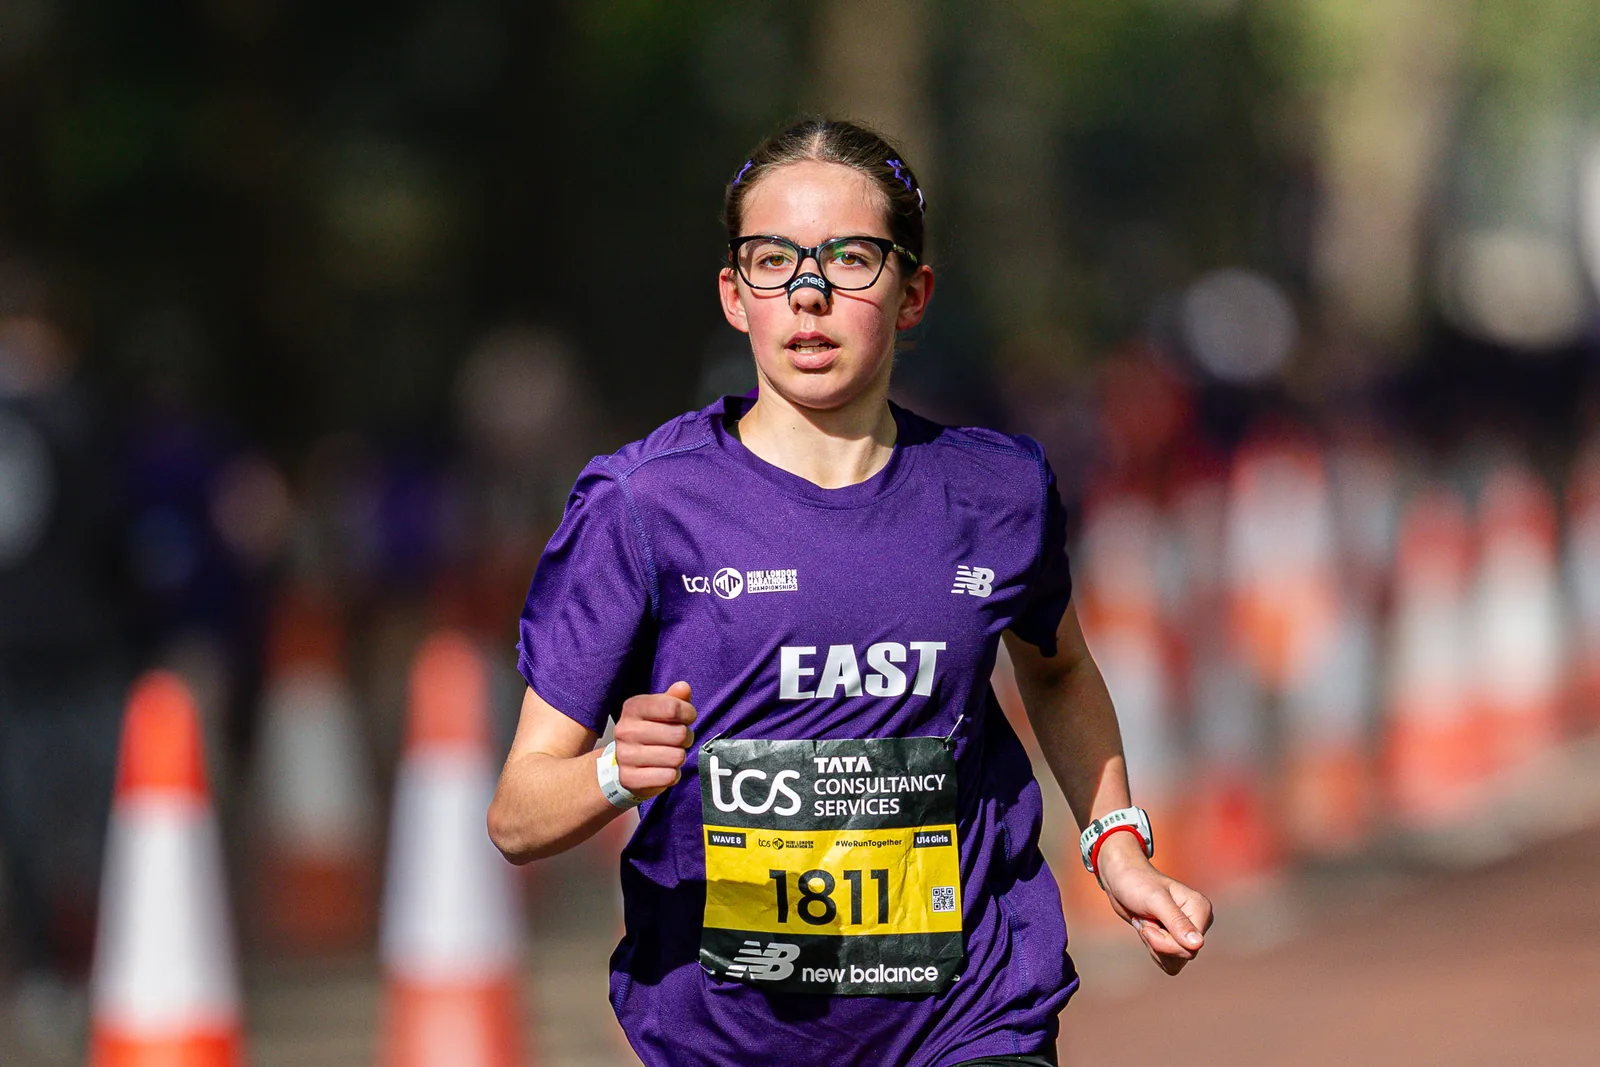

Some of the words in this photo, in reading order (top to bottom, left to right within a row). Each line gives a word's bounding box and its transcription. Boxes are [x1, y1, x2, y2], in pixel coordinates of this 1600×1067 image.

[747, 571, 764, 579] MINI
[765, 569, 797, 578] LONDON
[747, 577, 786, 586] MARATHON
[682, 574, 711, 594] tcs
[748, 584, 797, 592] CHAMPIONSHIPS
[779, 641, 947, 700] EAST
[814, 756, 872, 774] TATA
[709, 755, 802, 816] tcs
[813, 774, 946, 796] CONSULTANCY
[814, 798, 900, 817] SERVICES
[712, 835, 735, 844] WAVE
[736, 837, 742, 845] 8
[758, 838, 771, 848] tcs
[835, 839, 903, 849] #WeRunTogether
[916, 836, 930, 844] U14
[931, 835, 949, 844] Girls
[769, 868, 889, 926] 1811
[802, 966, 846, 983] new
[850, 963, 939, 983] balance
